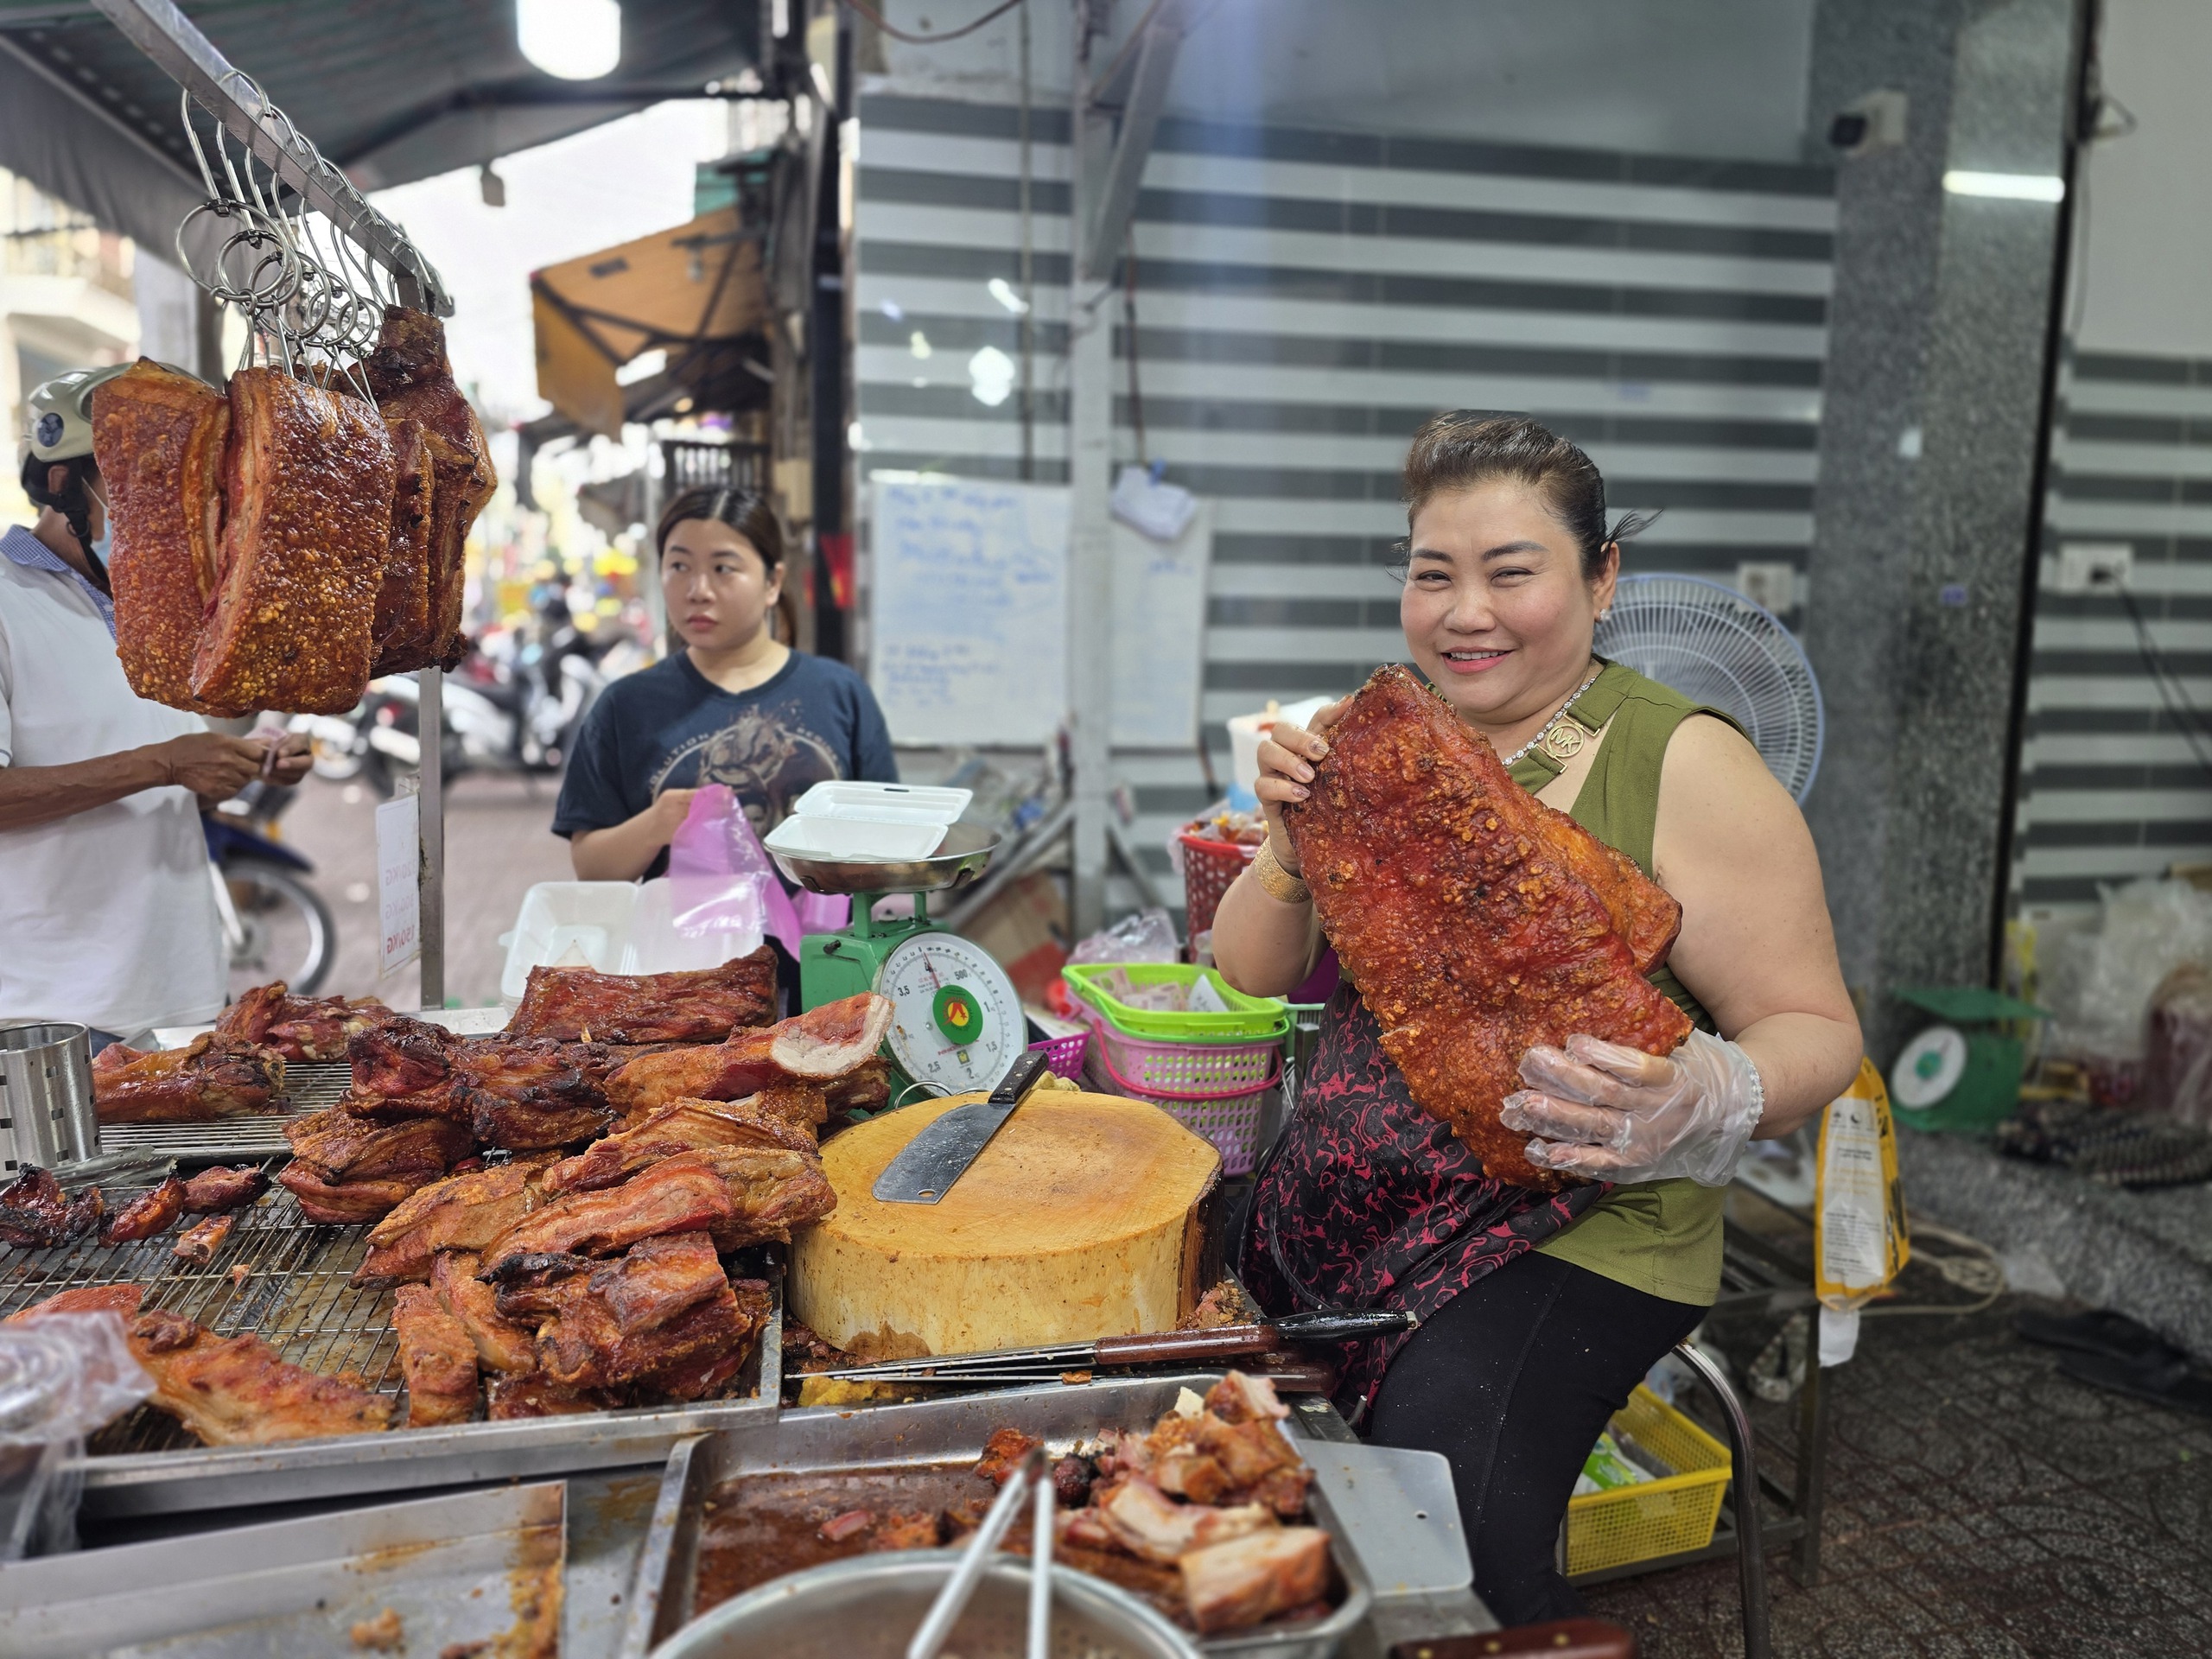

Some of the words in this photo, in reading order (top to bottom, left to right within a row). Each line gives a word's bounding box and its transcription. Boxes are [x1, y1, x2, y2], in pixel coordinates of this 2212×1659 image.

[1550, 727, 1580, 753] MK
[954, 969, 968, 981] 500
[898, 985, 910, 996] 3,5
[986, 1040, 998, 1052] 1,5
[928, 1060, 942, 1073] 2,5
[966, 1067, 975, 1079] 2
